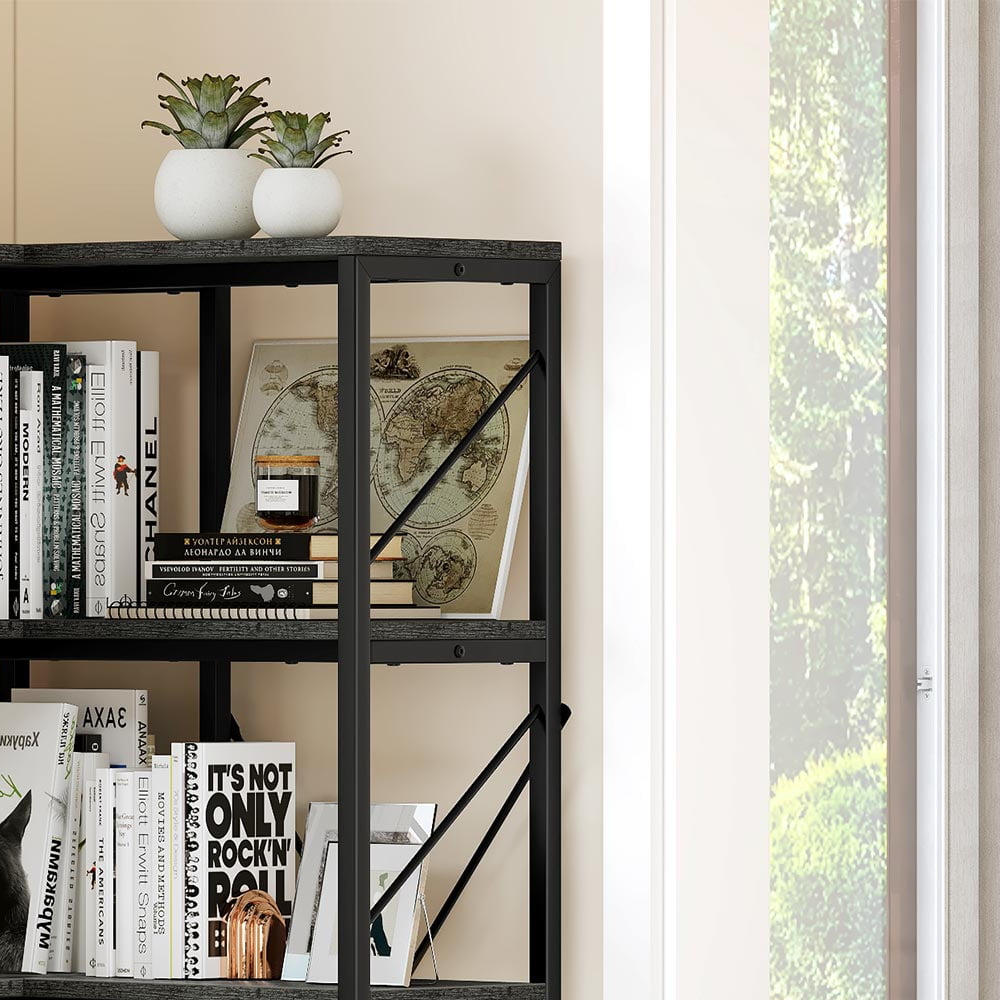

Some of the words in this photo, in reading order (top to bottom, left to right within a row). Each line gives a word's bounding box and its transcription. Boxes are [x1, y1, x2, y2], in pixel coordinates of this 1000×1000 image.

[51, 393, 62, 454] MATHEMATICAL
[51, 458, 62, 489] MOSAIC
[184, 548, 232, 556] ЛЕОНАРДО
[234, 548, 247, 556] ДА
[250, 548, 282, 556] ВИНЧИ
[137, 776, 149, 824] Elliott
[208, 764, 245, 792] IT'S
[249, 763, 293, 791] NOT
[157, 792, 165, 842] MOVIES
[205, 792, 293, 840] ONLY
[137, 832, 149, 884] Erwitt
[157, 846, 165, 872] AND
[208, 838, 292, 868] ROCK'N'
[137, 892, 149, 954] Snaps
[157, 875, 165, 934] METHODS
